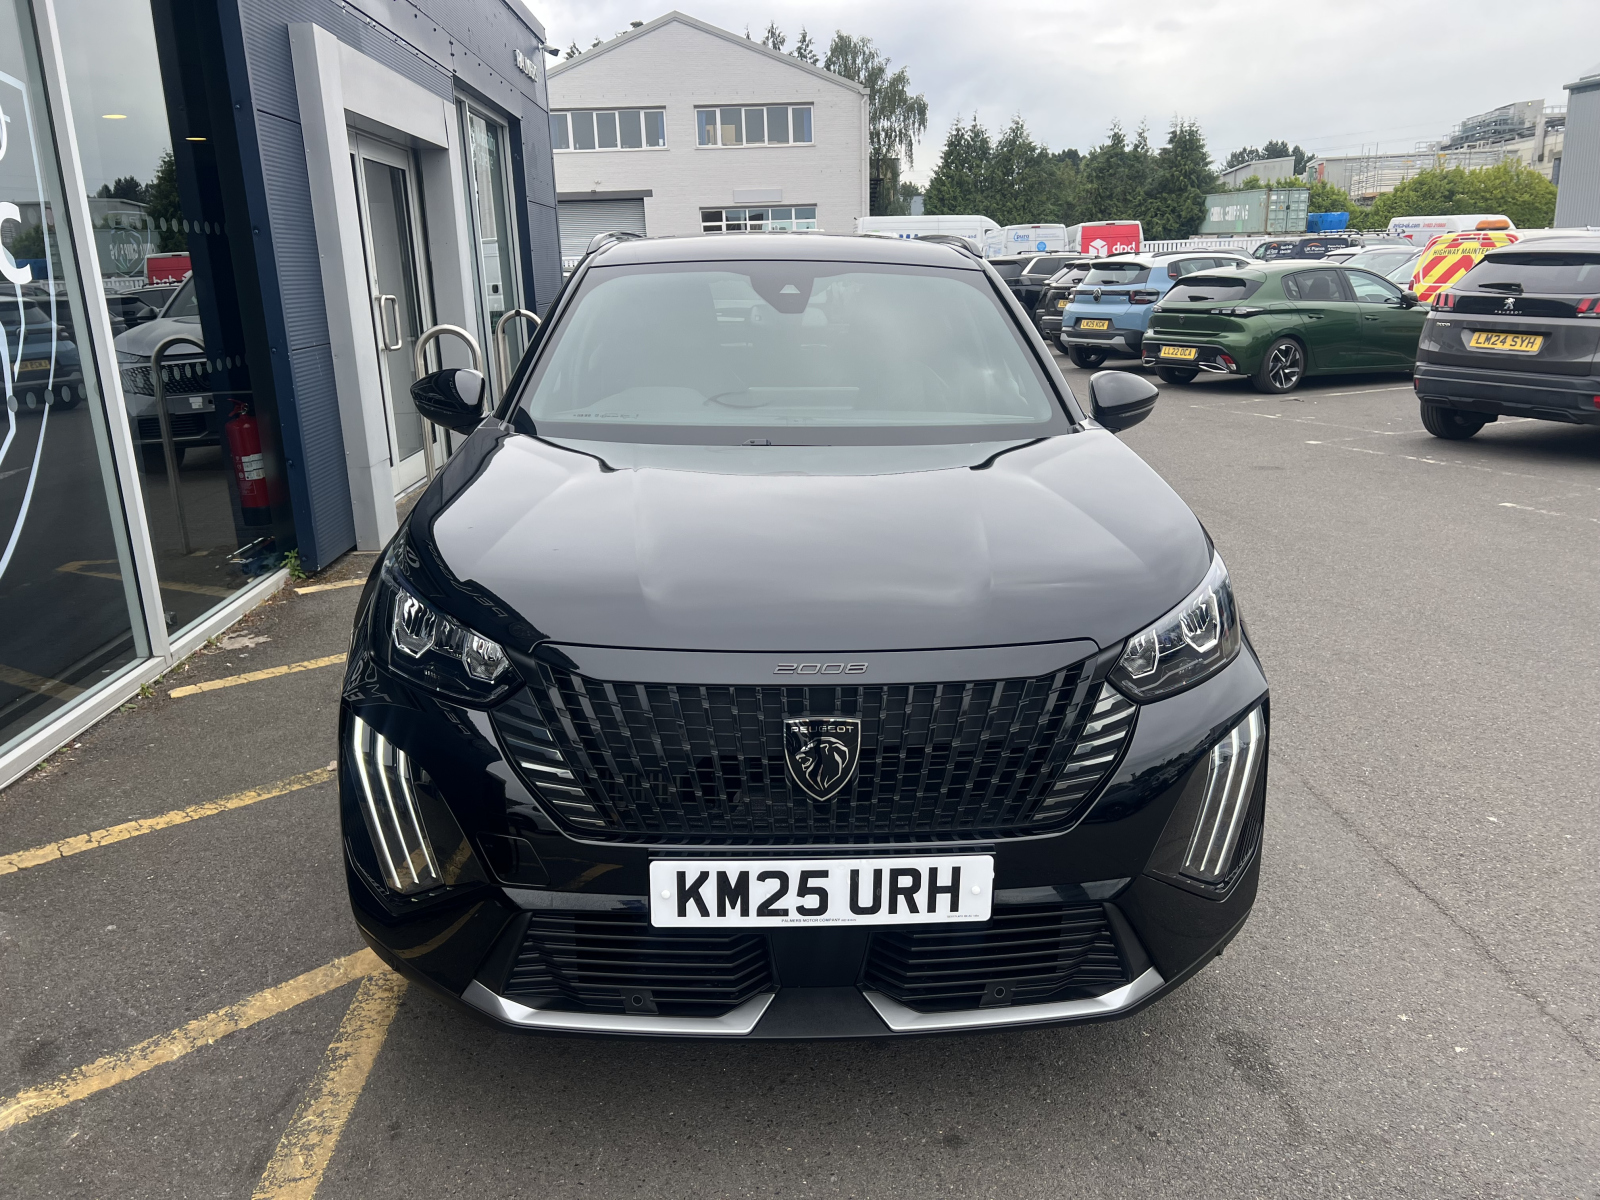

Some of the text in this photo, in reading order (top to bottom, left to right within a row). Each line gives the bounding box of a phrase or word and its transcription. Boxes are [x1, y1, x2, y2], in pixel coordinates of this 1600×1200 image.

[1112, 241, 1135, 253] dpd
[1432, 248, 1460, 256] HIGHWAY
[1476, 333, 1536, 349] LM24 SYH
[1163, 346, 1179, 356] LL22
[773, 662, 869, 674] 2008
[790, 725, 854, 733] PEUGEOT
[676, 866, 962, 918] KM25 URH
